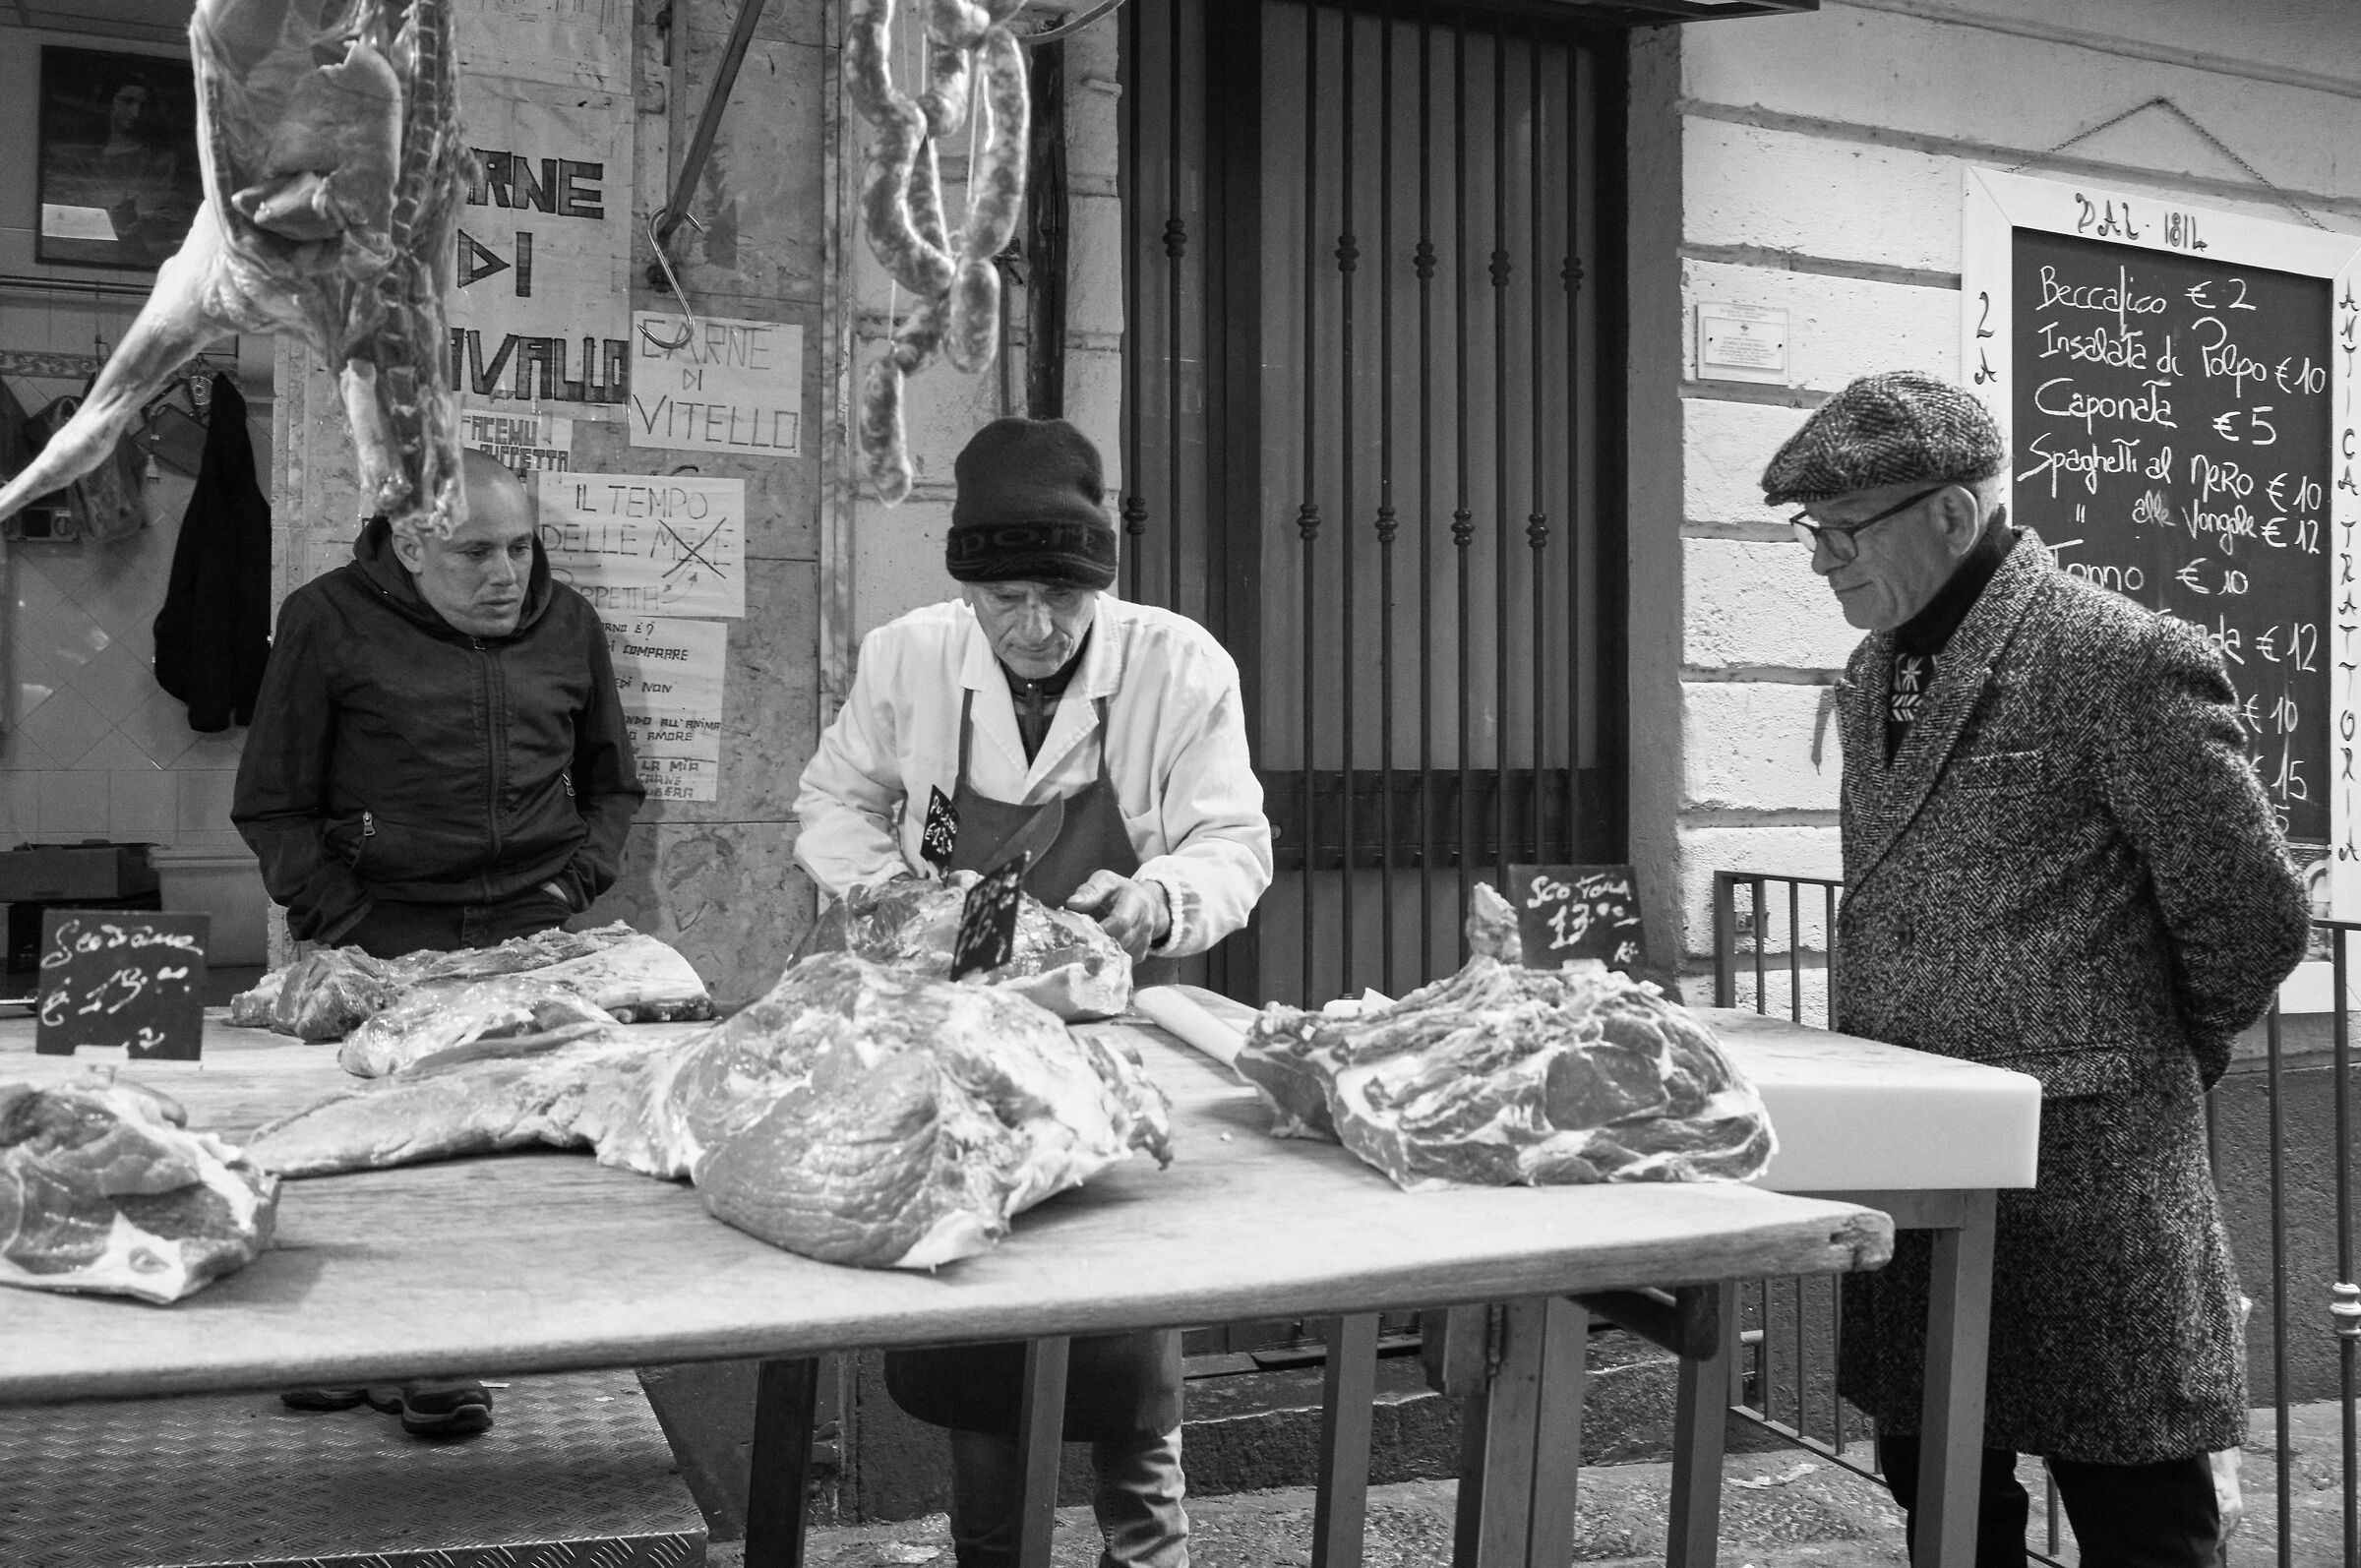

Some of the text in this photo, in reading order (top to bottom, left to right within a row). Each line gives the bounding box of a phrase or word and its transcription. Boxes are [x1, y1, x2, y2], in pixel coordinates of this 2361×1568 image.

[465, 147, 604, 219] RNE
[457, 228, 532, 298] DI
[682, 368, 703, 392] DI
[2037, 321, 2147, 371] Insalata
[2155, 334, 2184, 378] di
[2191, 316, 2268, 398] Polpo
[2034, 378, 2178, 435] Caponata
[2338, 276, 2360, 497] ANTICA
[632, 394, 800, 450] VITELLO
[2017, 432, 2141, 499] Spaghetti
[2145, 446, 2172, 484] al
[576, 483, 708, 520] IL TEMPO
[542, 523, 637, 556] DELLE
[623, 644, 689, 661] COMPRARE
[641, 681, 673, 694] NON
